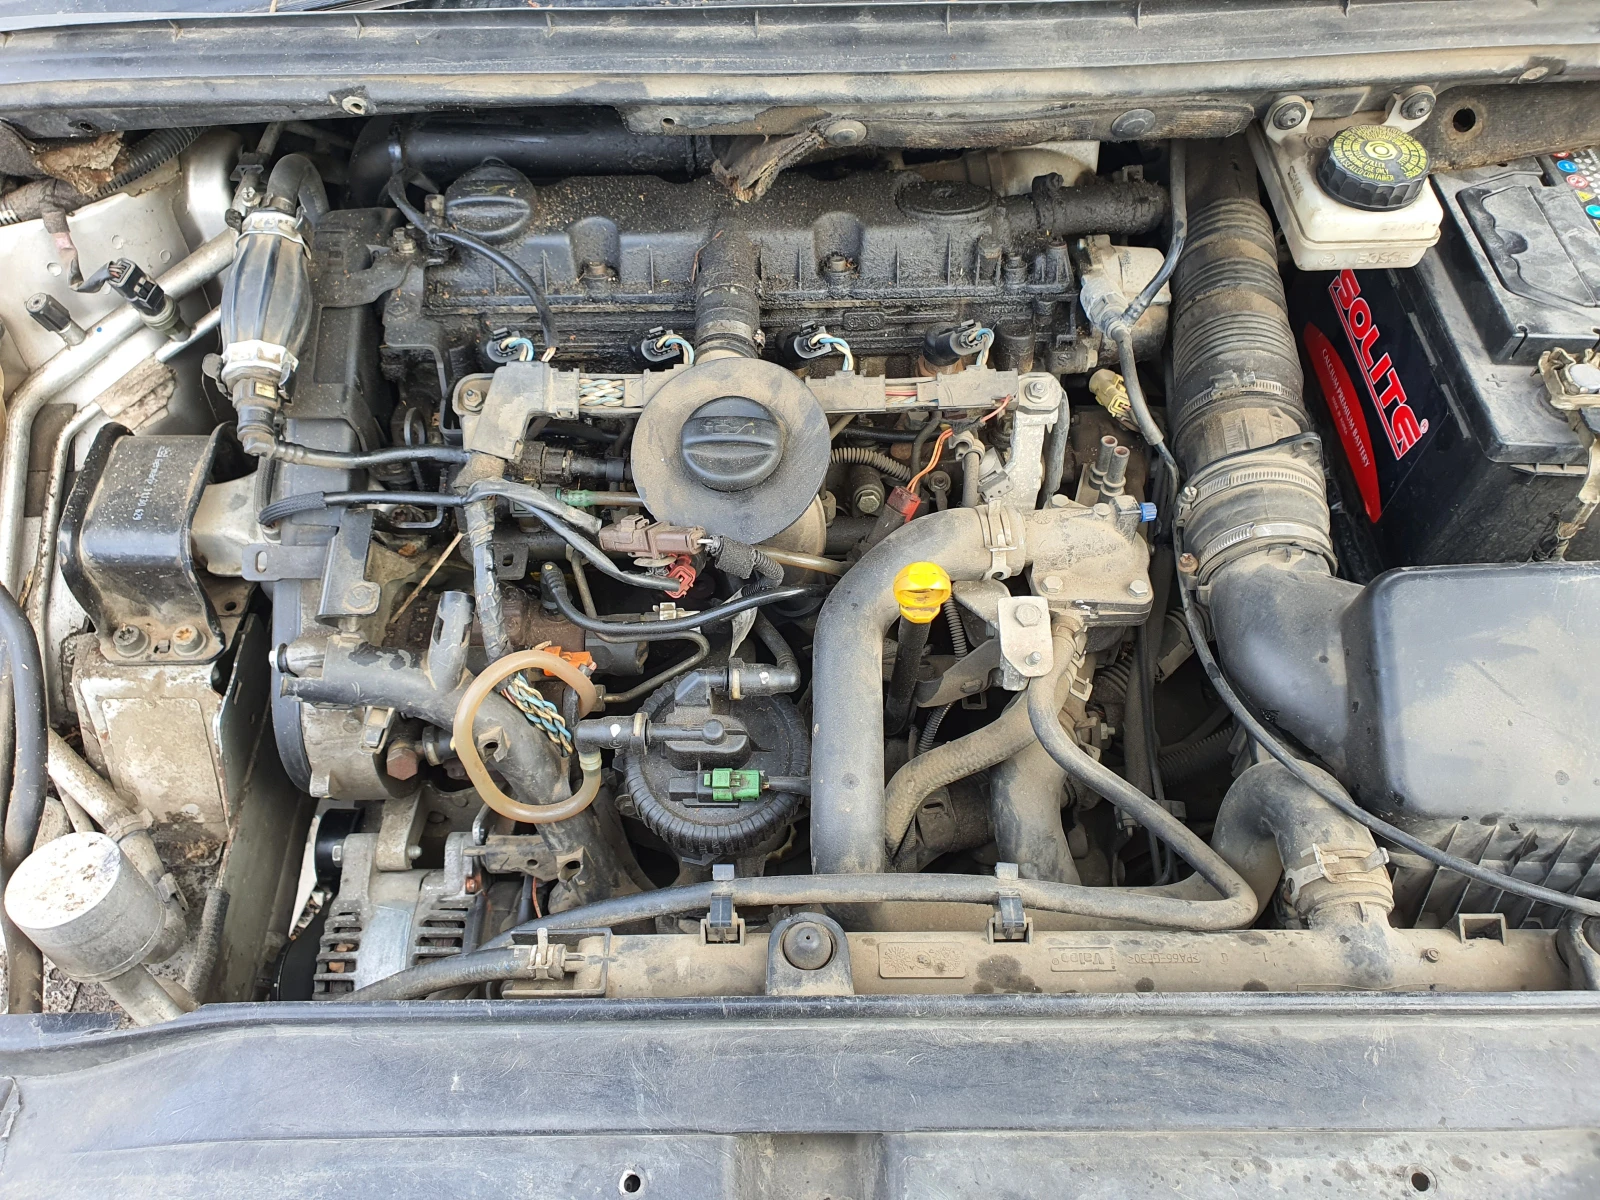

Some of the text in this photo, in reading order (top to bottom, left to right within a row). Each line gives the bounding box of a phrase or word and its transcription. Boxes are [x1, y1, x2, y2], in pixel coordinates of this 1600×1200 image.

[1322, 348, 1371, 468] CALCIUM PREMIUM BATTERY
[1328, 268, 1422, 460] SOLITE
